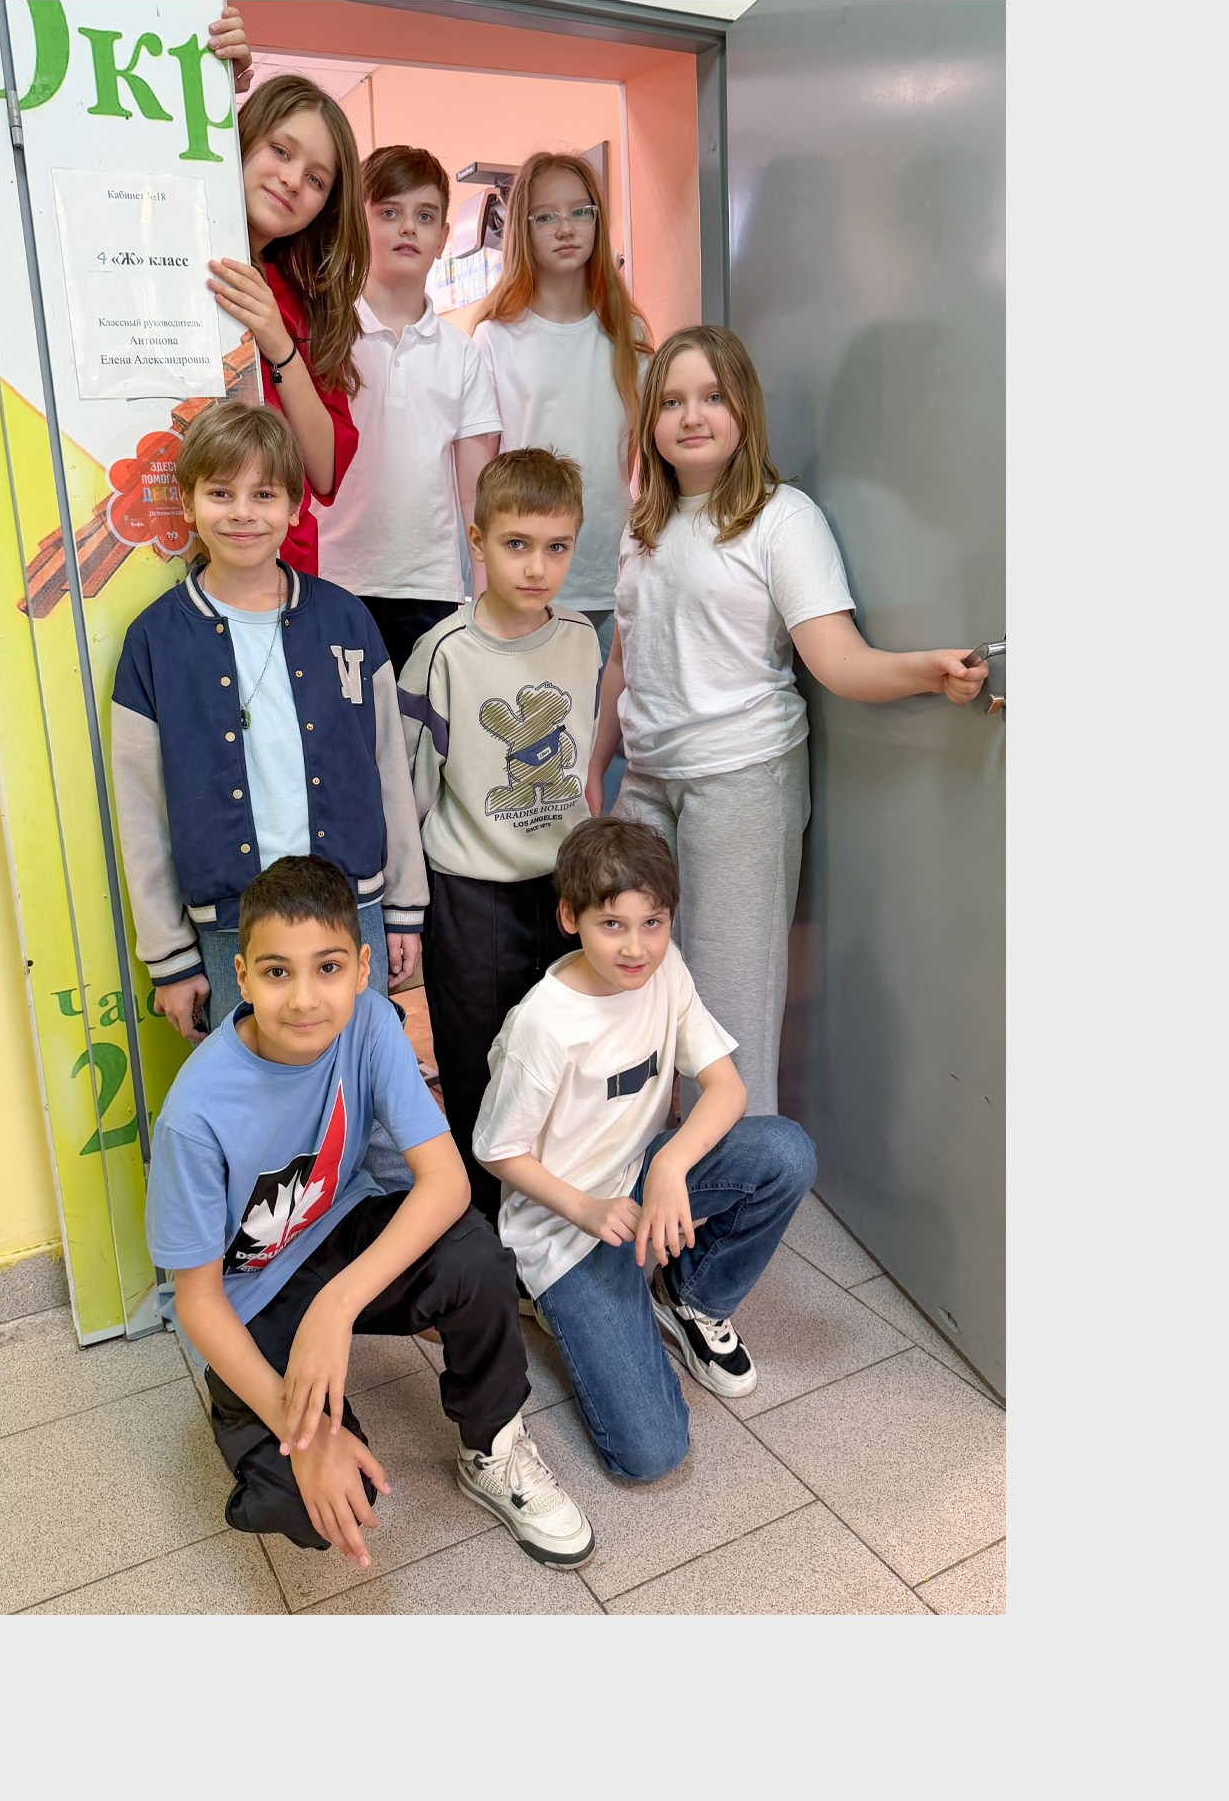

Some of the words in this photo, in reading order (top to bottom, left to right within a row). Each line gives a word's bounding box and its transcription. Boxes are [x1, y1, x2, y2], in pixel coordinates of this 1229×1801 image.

[97, 251, 107, 265] 4
[111, 252, 145, 266] «Ж»
[148, 256, 190, 267] класс
[98, 317, 142, 328] Классный
[143, 319, 204, 329] руководитель:
[129, 336, 179, 346] Антонова
[100, 355, 132, 365] Елена
[134, 355, 211, 367] Александровна
[494, 809, 539, 822] PARADISE
[513, 820, 529, 828] LOS
[530, 814, 563, 826] ANGELES
